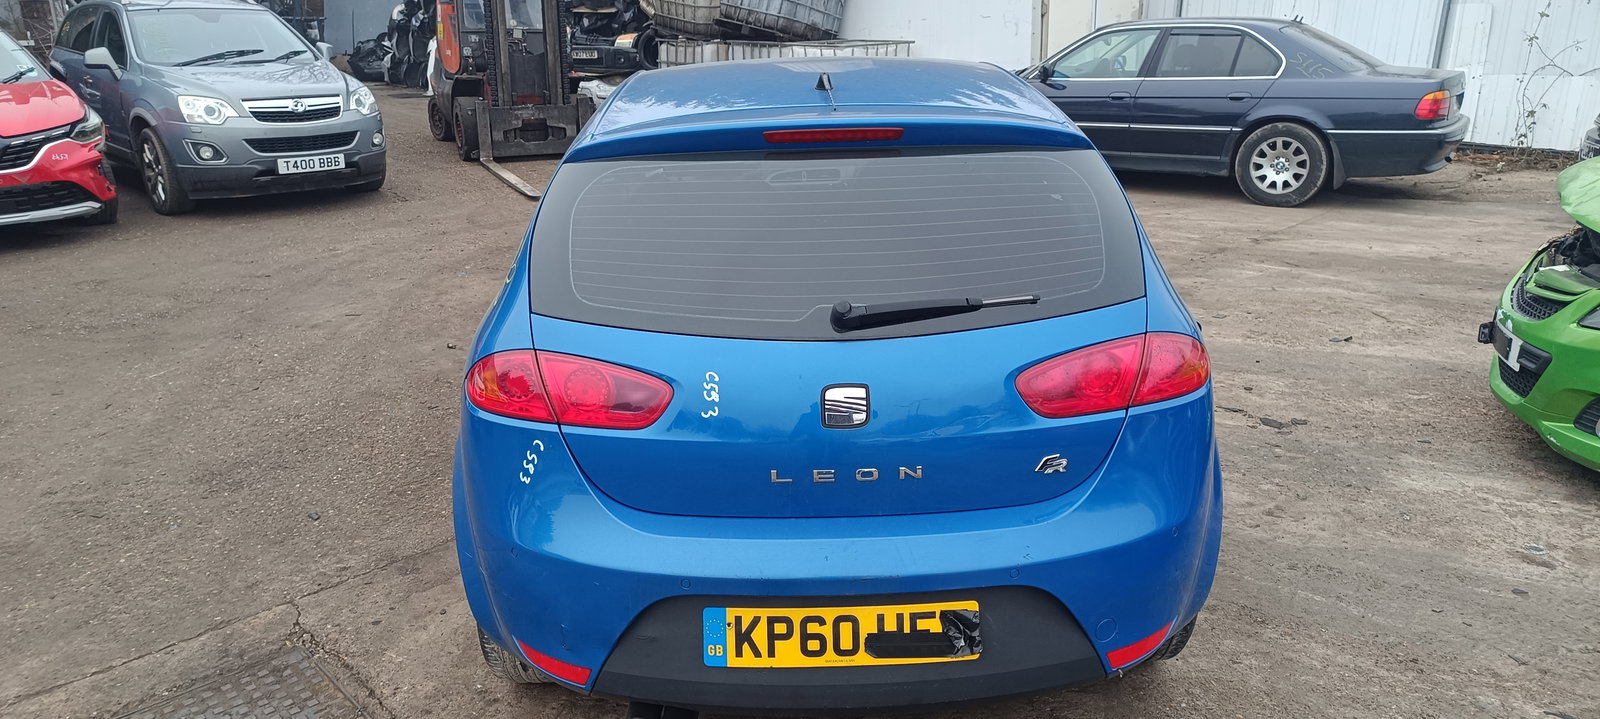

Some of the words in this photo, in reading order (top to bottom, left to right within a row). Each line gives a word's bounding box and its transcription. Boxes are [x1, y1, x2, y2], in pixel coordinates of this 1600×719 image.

[283, 159, 316, 171] T400
[318, 156, 341, 169] BBB
[1034, 453, 1068, 474] FR
[770, 465, 923, 483] LEON
[734, 614, 861, 659] KP60
[707, 644, 724, 656] GB
